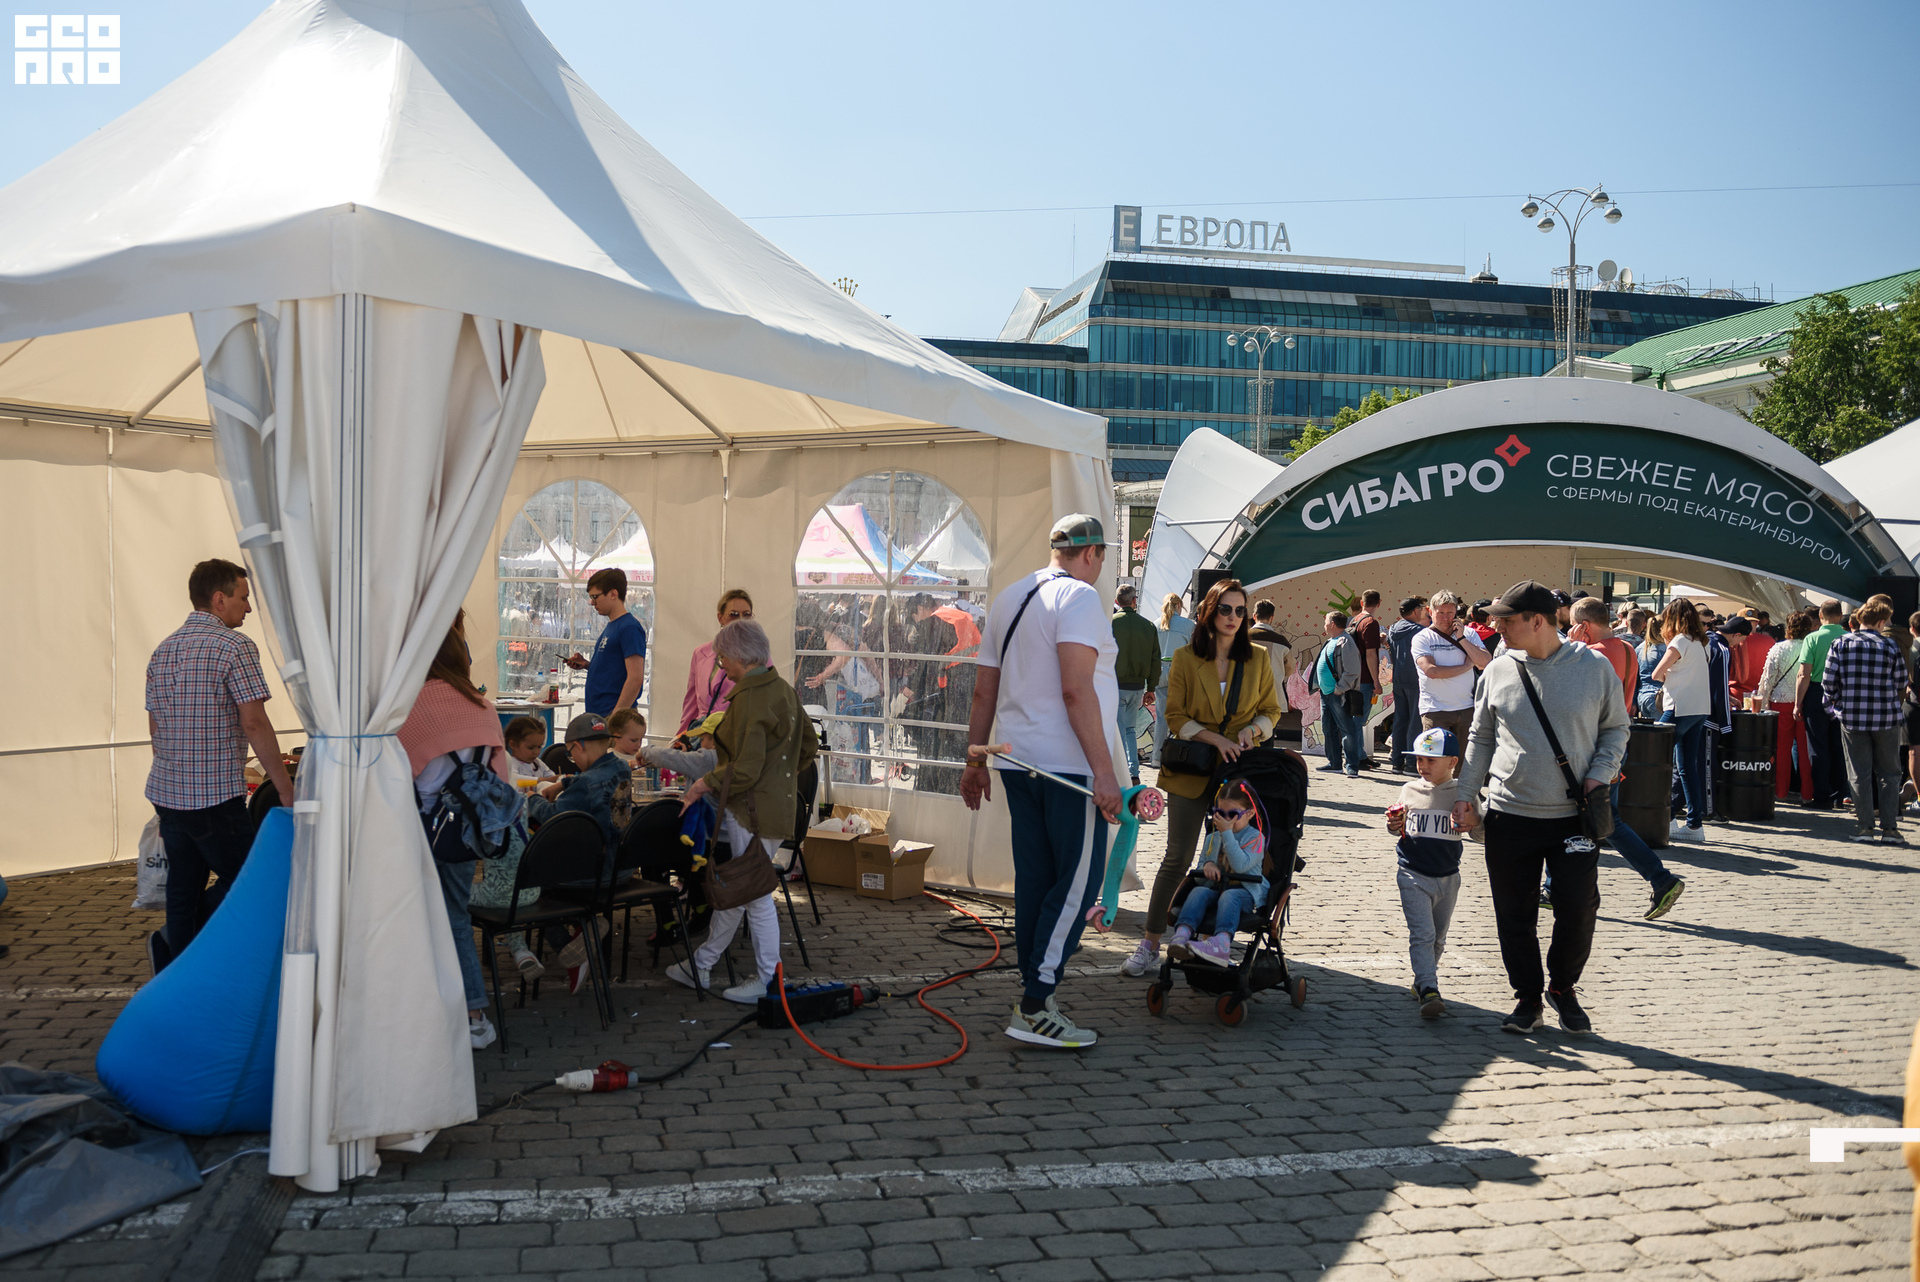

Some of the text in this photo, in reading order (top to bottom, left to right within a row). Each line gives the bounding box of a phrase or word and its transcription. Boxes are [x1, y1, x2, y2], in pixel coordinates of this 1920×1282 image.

[1157, 214, 1292, 253] ЕВРОПА
[1301, 458, 1505, 531] СИБАГРО
[1546, 453, 1814, 525] СВЕЖЕЕ МЯСО
[1546, 485, 1851, 571] С ФЕРМЫ ПОД ЕКАТЕРИНБУРГОМ
[1721, 760, 1772, 772] СИБАГРО
